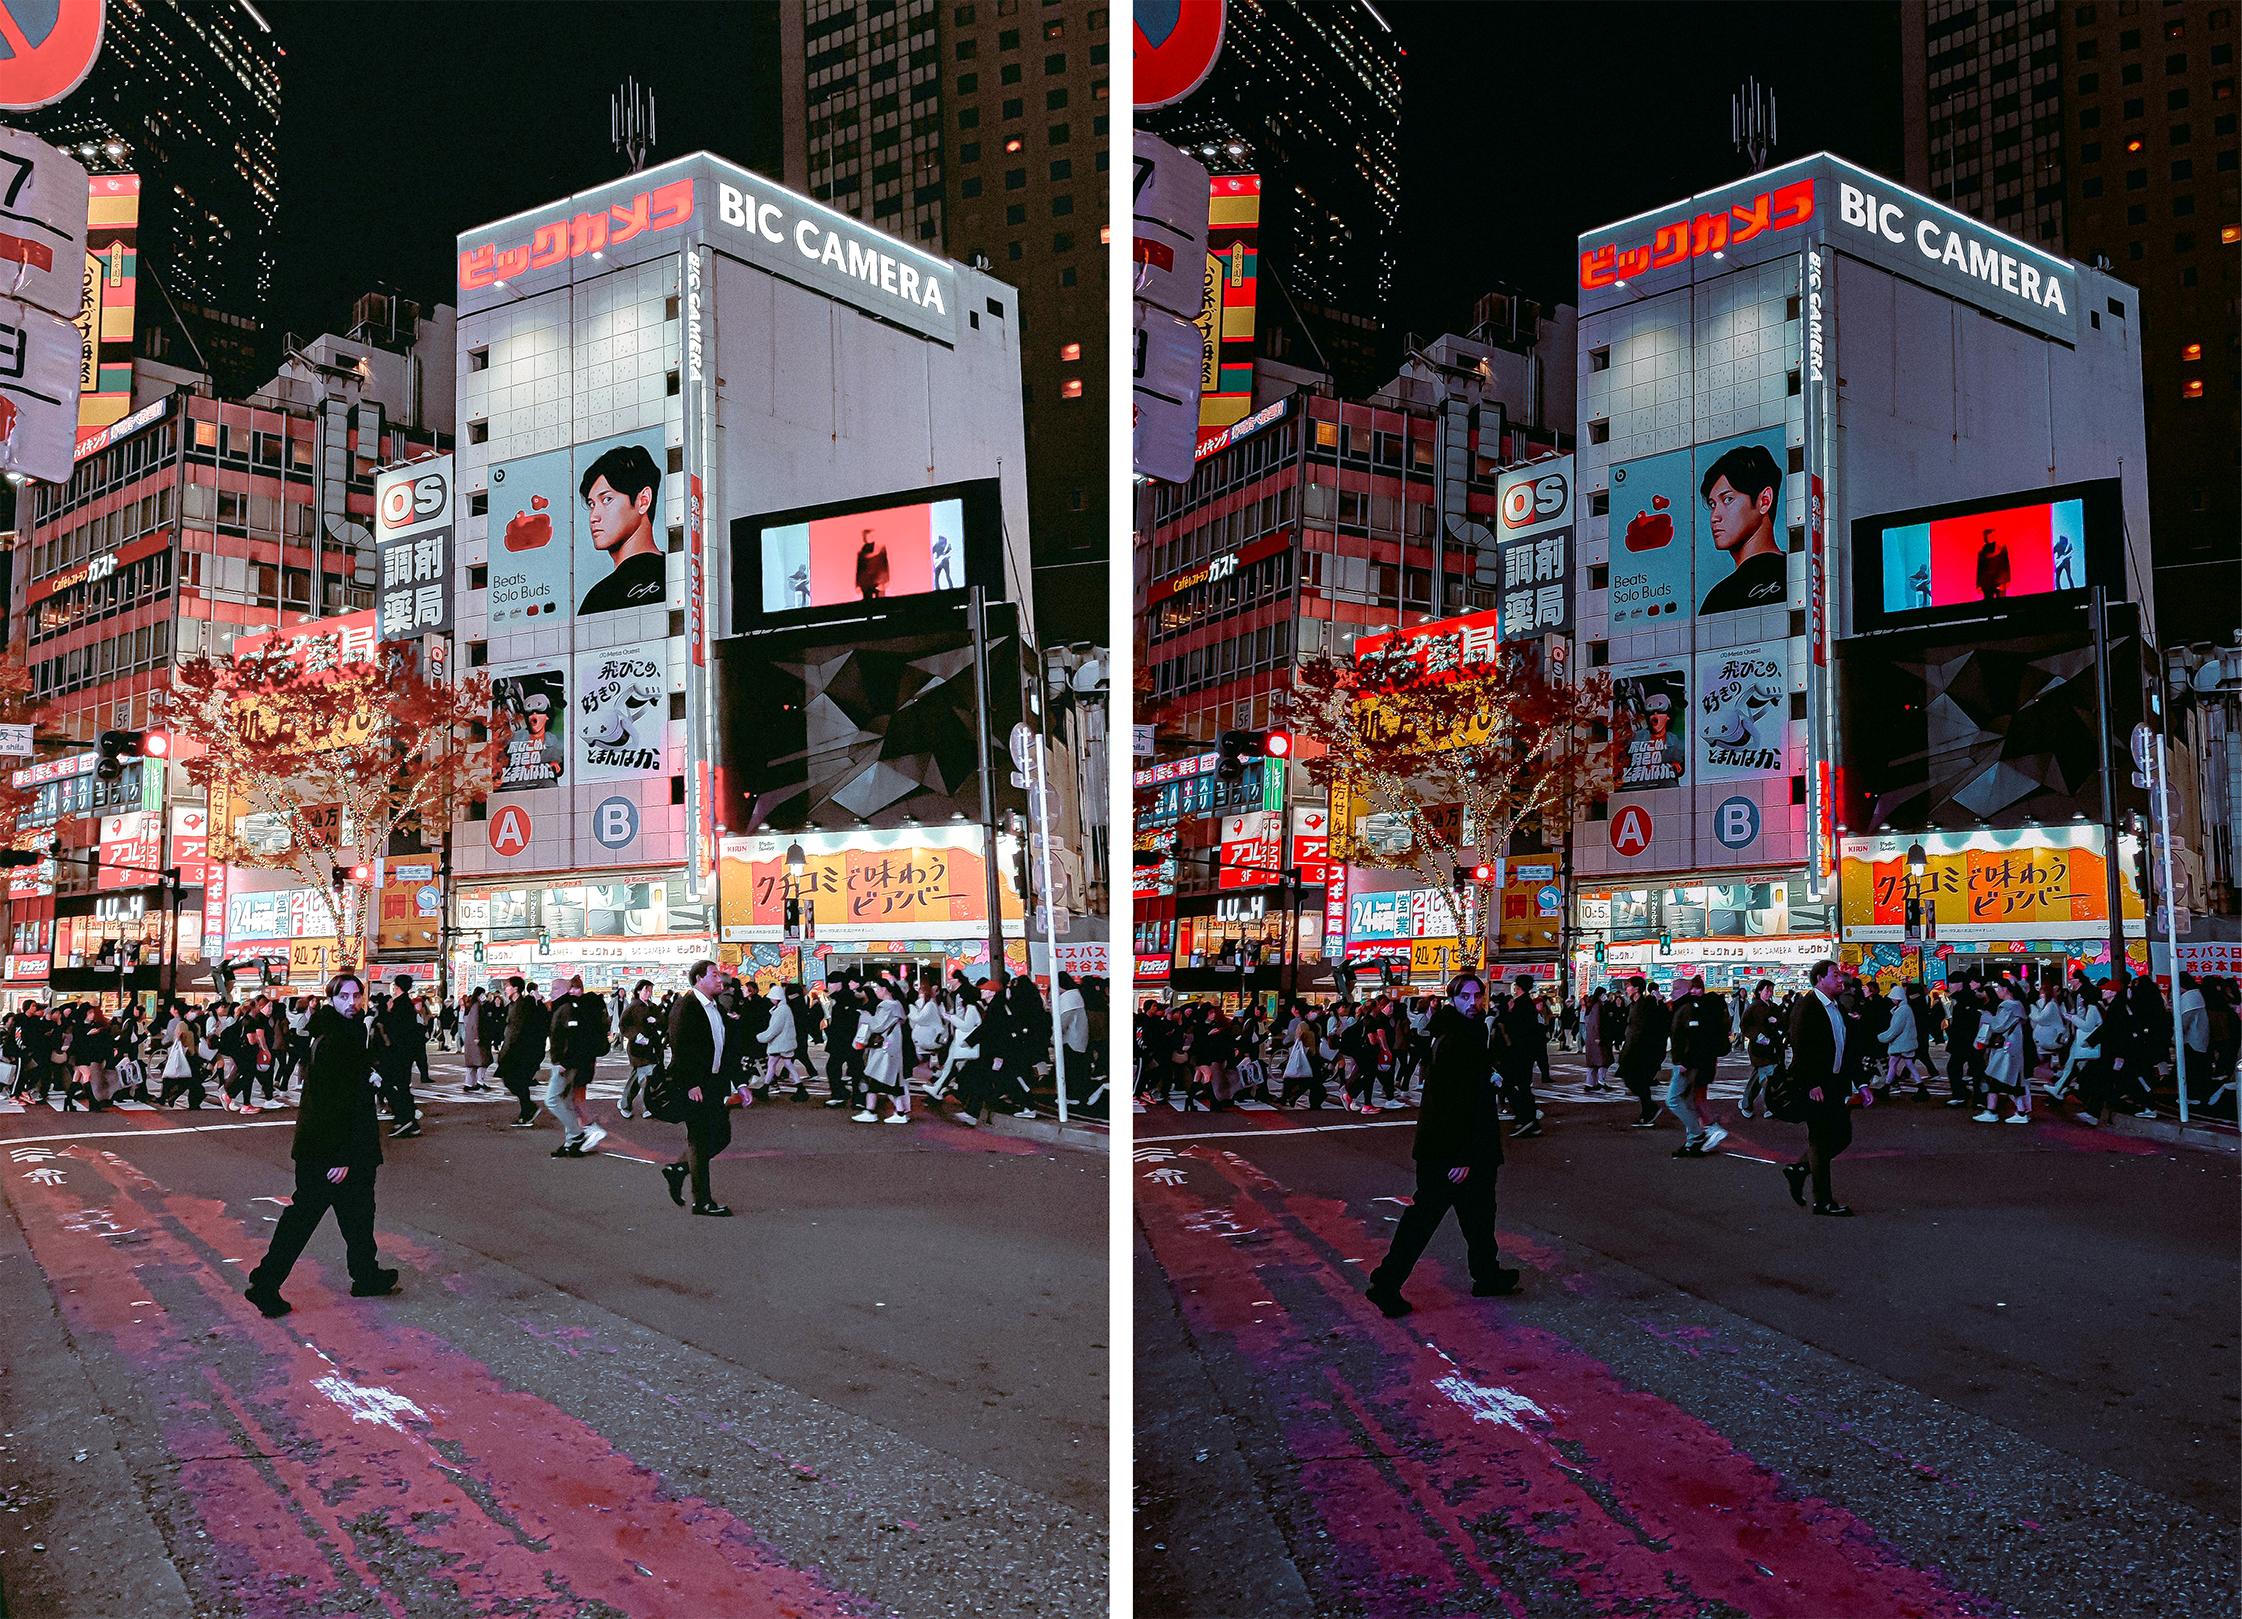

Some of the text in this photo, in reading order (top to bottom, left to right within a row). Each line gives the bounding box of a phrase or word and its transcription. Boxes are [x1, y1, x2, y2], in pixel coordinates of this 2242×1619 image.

[459, 178, 693, 290] ビックカメラ
[720, 181, 946, 315] BIC CAMERA
[1580, 178, 1814, 290] ビックカメラ
[1841, 181, 2067, 315] BIC CAMERA
[386, 475, 445, 528] OS
[1507, 475, 1566, 528] OS
[87, 552, 119, 583] ガスト
[383, 534, 444, 589] 調剤
[1208, 552, 1240, 583] ガスト
[1504, 534, 1565, 589] 調剤
[492, 584, 551, 604] Solo Buds
[493, 573, 526, 589] Beats
[1613, 584, 1672, 604] Solo Buds
[1614, 573, 1647, 589] Beats
[383, 584, 444, 636] 薬局
[1504, 584, 1565, 636] 薬局
[432, 648, 443, 676] OS
[1553, 648, 1564, 676] OS
[580, 681, 621, 715] 好きの
[1701, 681, 1742, 715] 好きの
[496, 811, 525, 848] A
[602, 805, 631, 842] B
[1617, 811, 1646, 848] A
[1723, 805, 1752, 842] B
[727, 845, 748, 853] KIRIN
[1848, 845, 1869, 853] KIRIN
[120, 870, 131, 883] 3F
[1241, 870, 1252, 883] 3F
[95, 895, 145, 922] LUH
[853, 885, 971, 917] ビアバー
[1216, 895, 1266, 922] LUH
[1974, 885, 2092, 917] ビアバー
[1065, 960, 1108, 972] 渋谷本
